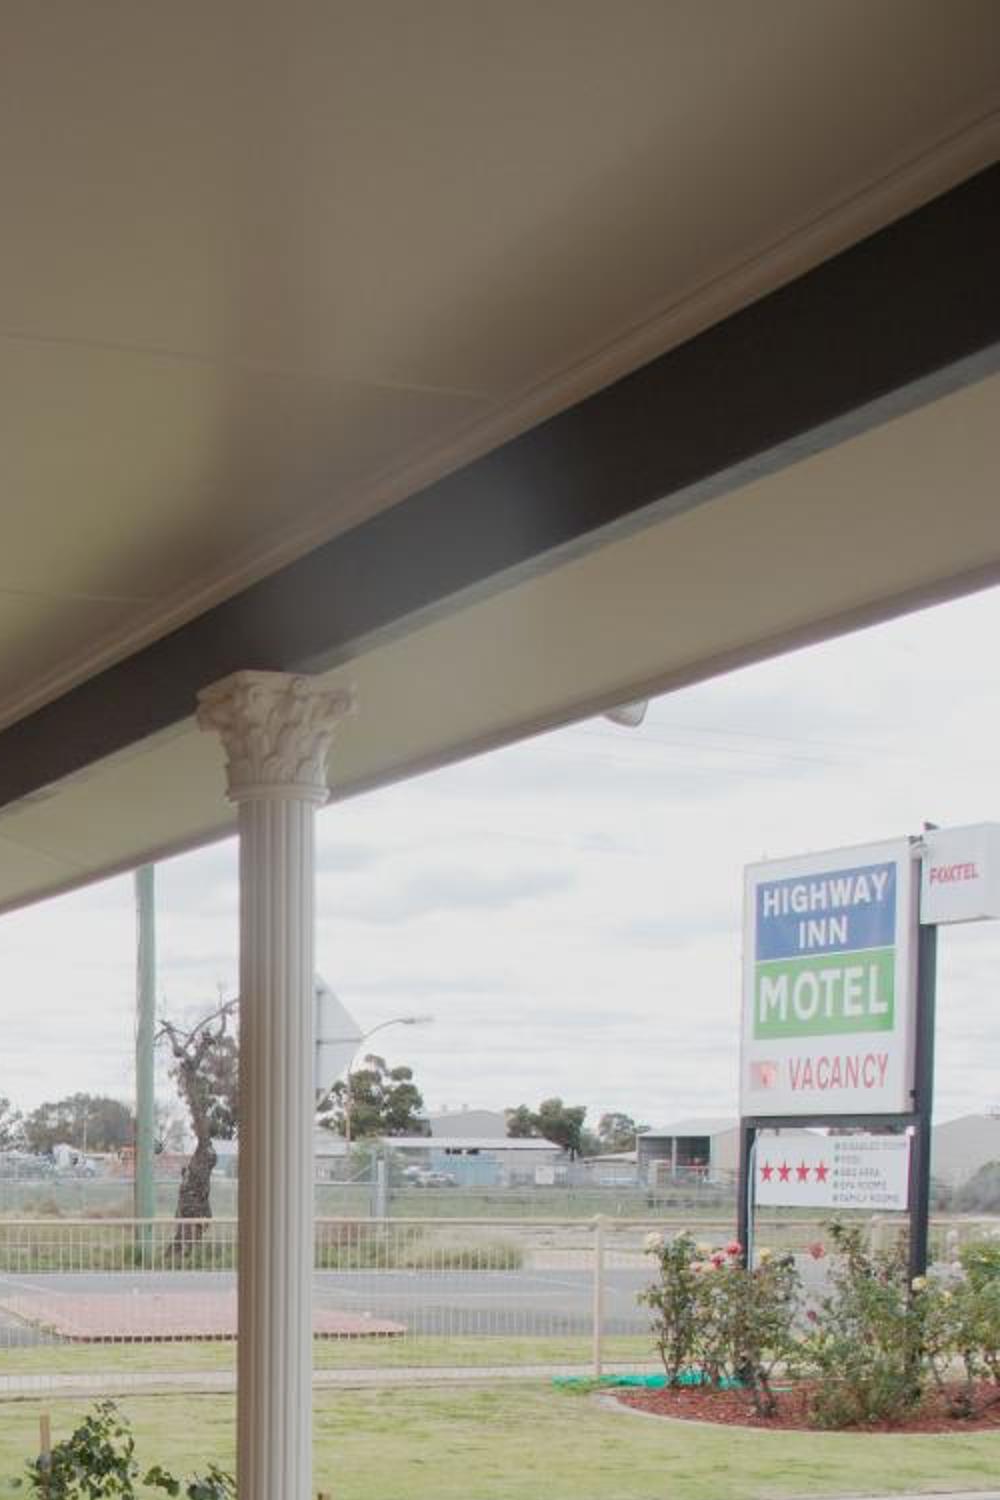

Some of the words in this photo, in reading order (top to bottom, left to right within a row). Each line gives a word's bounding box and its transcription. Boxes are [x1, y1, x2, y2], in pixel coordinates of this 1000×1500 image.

[929, 864, 979, 885] FOXTEL
[762, 872, 888, 917] HIGHWAY
[800, 916, 848, 949] INN
[759, 964, 888, 1023] MOTEL
[788, 1054, 889, 1090] VACANCY
